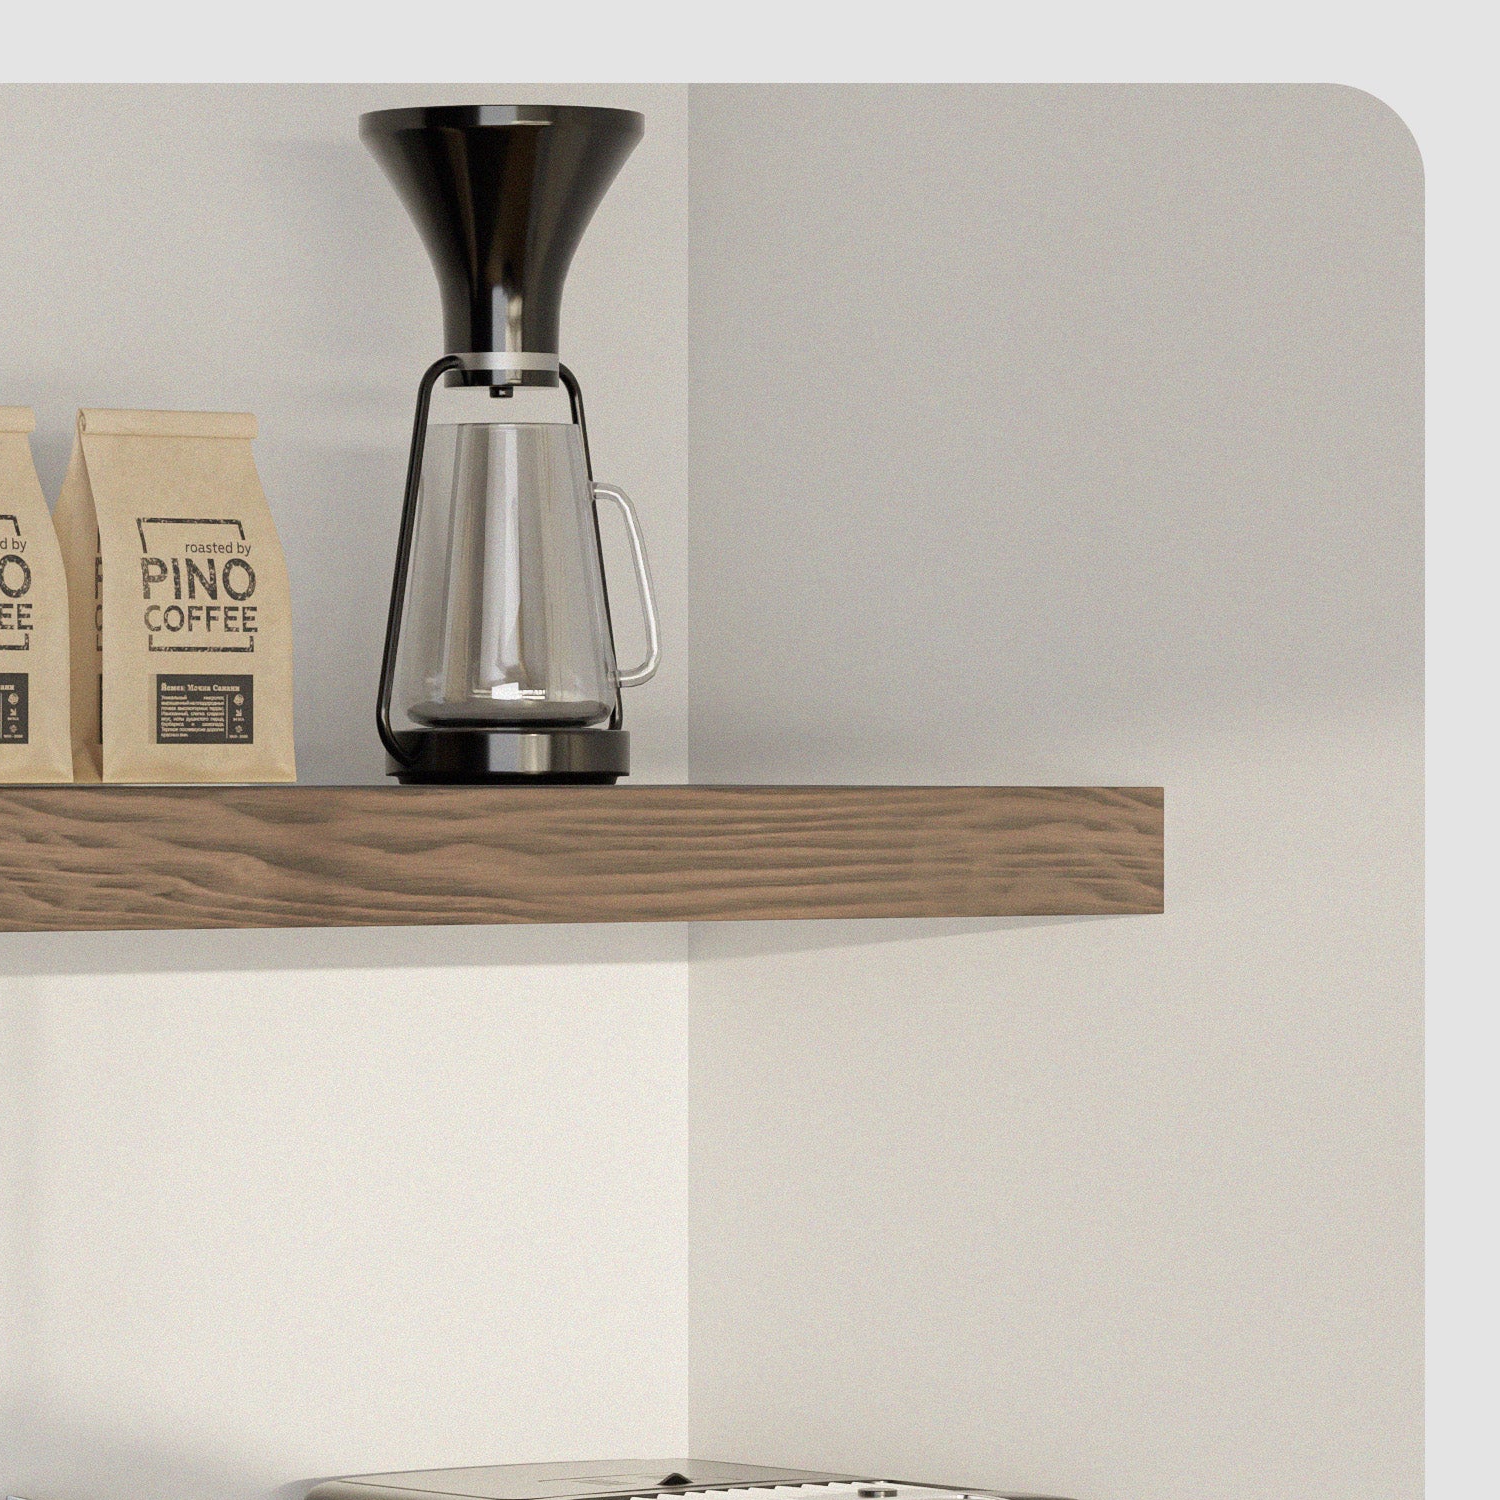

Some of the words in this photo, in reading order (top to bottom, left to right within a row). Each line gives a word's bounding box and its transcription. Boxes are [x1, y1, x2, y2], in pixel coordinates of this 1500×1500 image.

[11, 538, 27, 552] by
[185, 542, 233, 553] roasted
[236, 542, 251, 557] by
[140, 557, 256, 601] PINO
[144, 605, 258, 632] COFFEE
